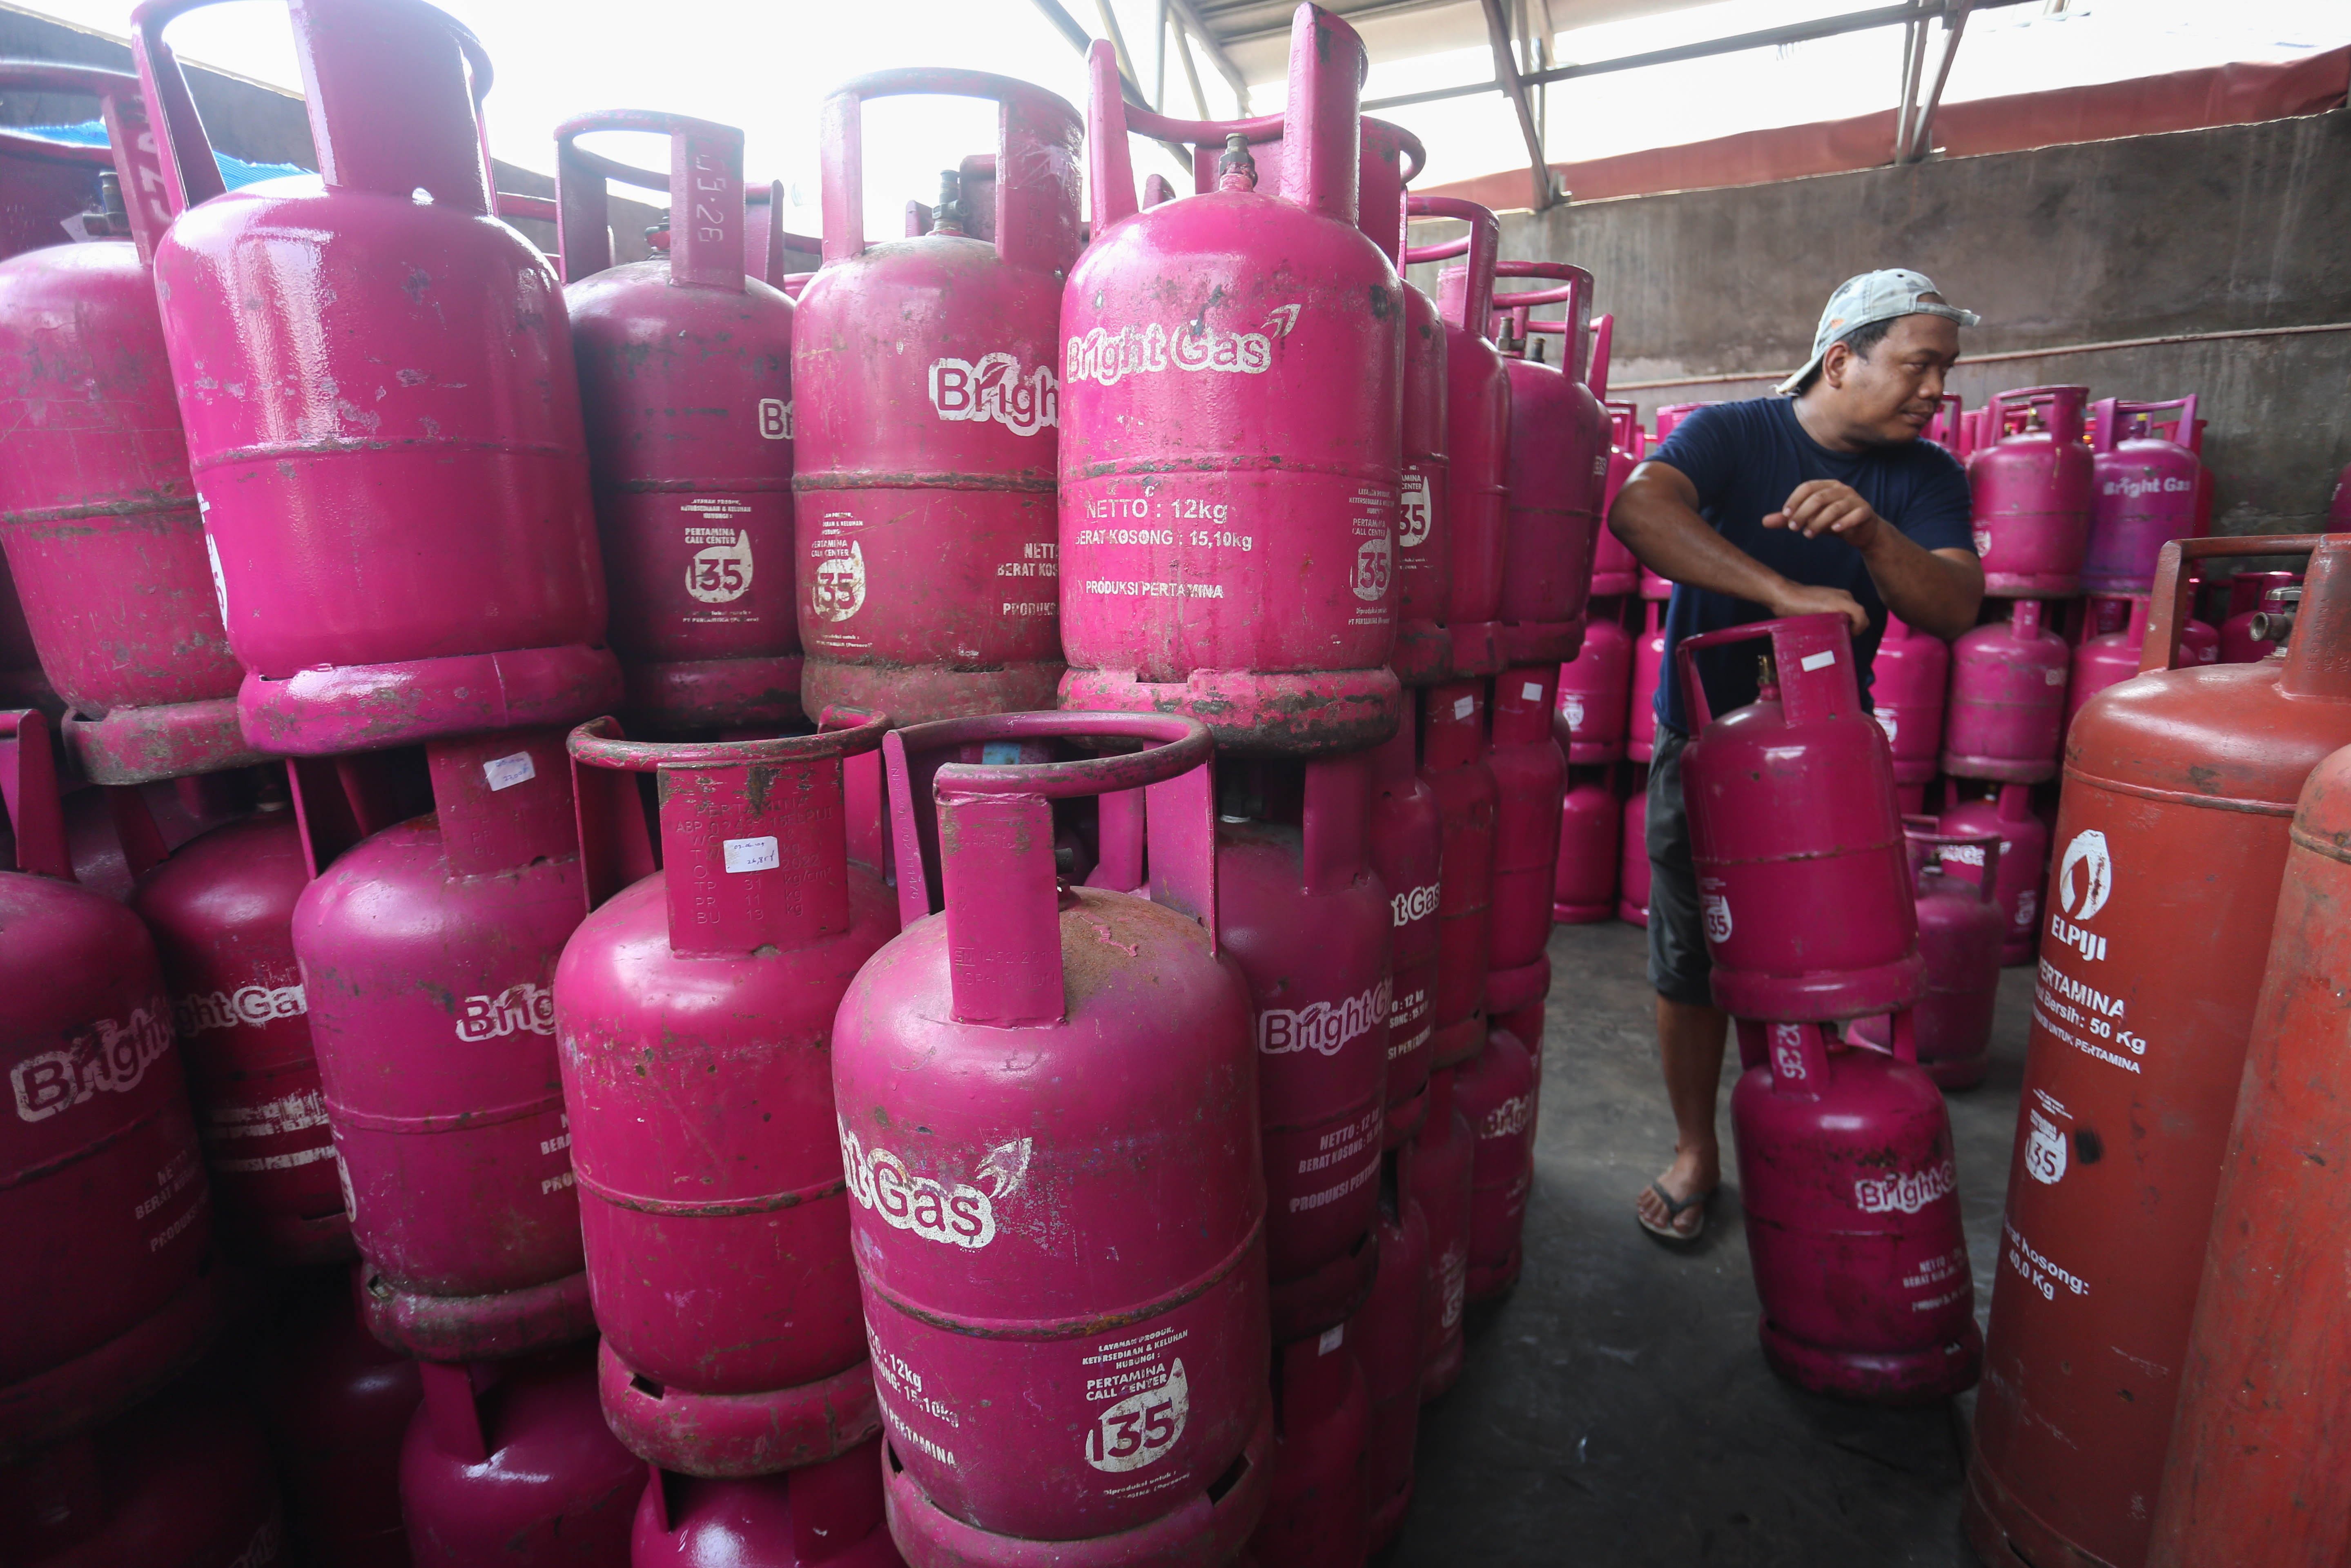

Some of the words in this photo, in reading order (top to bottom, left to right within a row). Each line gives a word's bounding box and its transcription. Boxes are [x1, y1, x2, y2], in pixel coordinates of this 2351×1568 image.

[1066, 323, 1167, 385] Bright
[1170, 325, 1271, 373] Gas
[2103, 477, 2161, 498] Bright
[2164, 477, 2191, 492] Gas
[1087, 498, 1148, 519] NETTO
[1171, 498, 1228, 524] 12kg
[684, 527, 735, 536] PERTAMINA
[1109, 529, 1173, 546] KOSONG
[1190, 530, 1252, 552] 15,10kg
[691, 558, 742, 592] 135
[996, 562, 1035, 577] BERAT
[1352, 552, 1387, 588] 135
[1086, 579, 1139, 596] PRODUKSI
[1142, 581, 1224, 599] PERTAMINA
[784, 889, 802, 902] kg
[696, 911, 721, 924] BU
[785, 903, 804, 918] kg
[2050, 913, 2107, 962] ELPIJI
[1259, 996, 1370, 1056] Bright
[2043, 989, 2086, 1029] Bersih:
[2089, 1016, 2111, 1039] 50
[2115, 1030, 2146, 1056] Kg
[2074, 1036, 2141, 1075] PERTAMINA
[1320, 1123, 1355, 1151] NETTO
[1298, 1154, 1331, 1174] BERAT
[1331, 1137, 1362, 1165] KOSONG
[868, 1148, 996, 1249] Gas
[1289, 1180, 1349, 1214] PRODUKSI
[1854, 1166, 1942, 1214] Bright
[2021, 1236, 2090, 1296] Kosong:
[2032, 1270, 2055, 1301] Kg
[1082, 1347, 1143, 1365] KETERSEDIAAN
[1145, 1344, 1152, 1352] &
[1154, 1329, 1188, 1349] KELUHAN
[1099, 1338, 1137, 1353] LAYANAN
[1115, 1352, 1155, 1370] HUBUNGI
[890, 1353, 922, 1393] 12kg
[1087, 1363, 1165, 1390] PERTAMINA
[1086, 1388, 1118, 1401] CALL
[1089, 1399, 1176, 1462] 135
